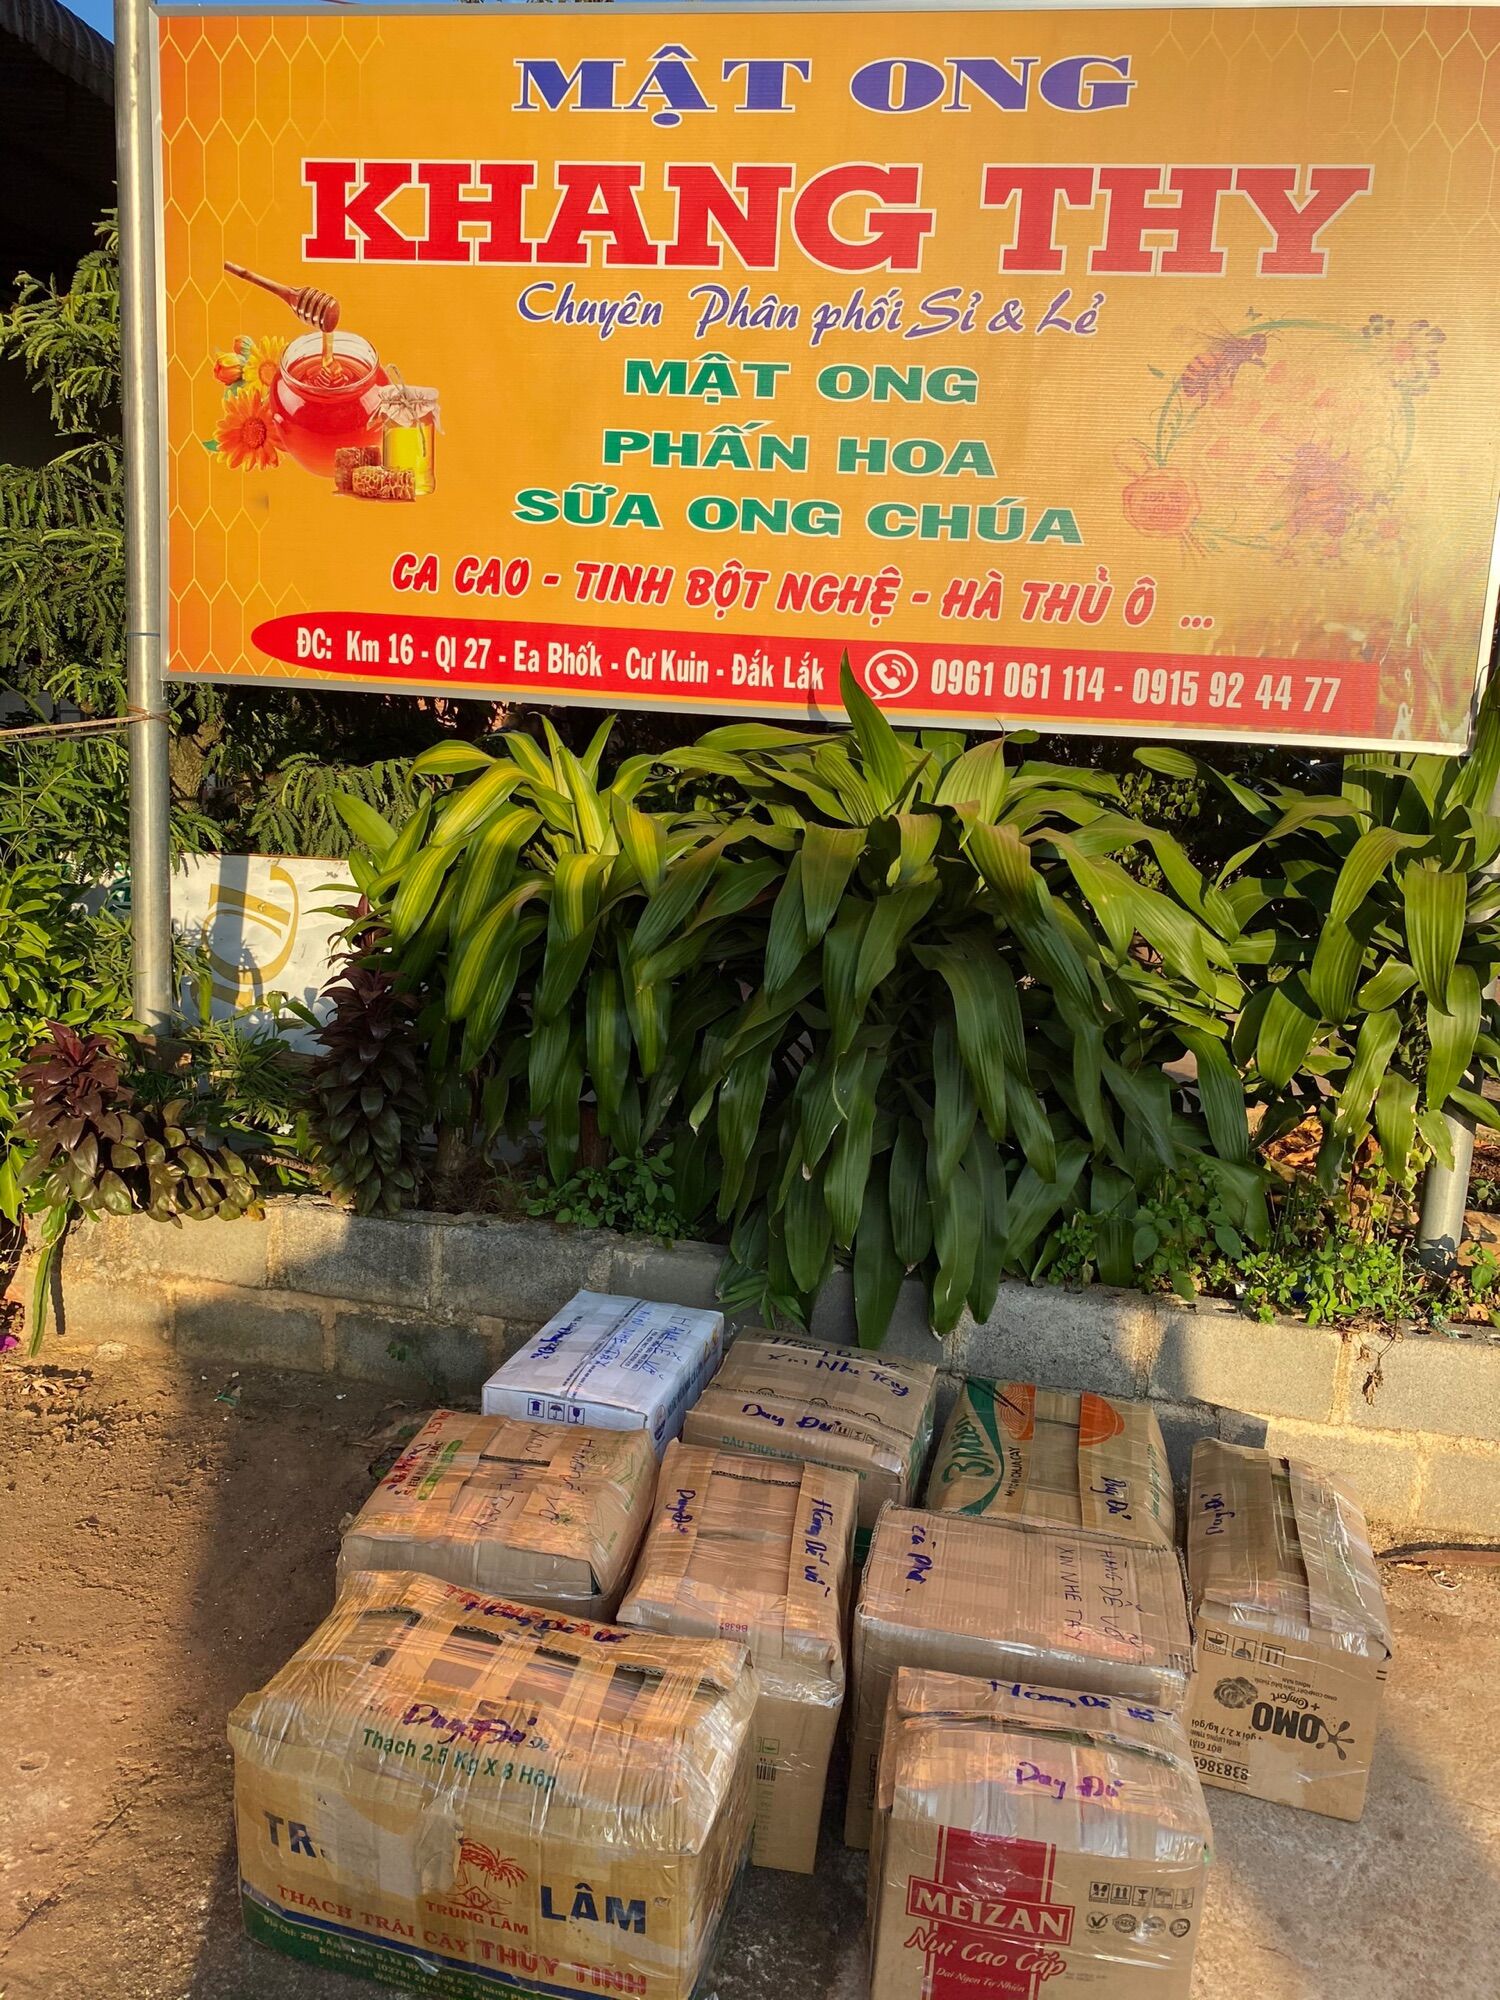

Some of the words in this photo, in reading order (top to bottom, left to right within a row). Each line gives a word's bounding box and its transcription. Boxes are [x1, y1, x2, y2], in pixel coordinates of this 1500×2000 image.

[513, 43, 811, 128] MẬT
[851, 55, 1137, 114] ONG
[301, 157, 935, 275] KHANG
[981, 163, 1374, 278] THY
[517, 281, 662, 339] Chuyên
[689, 284, 797, 339] Phân
[810, 286, 903, 346] phối
[904, 286, 981, 340] Sỉ
[988, 297, 1026, 332] &
[1037, 289, 1105, 338] Lẻ
[624, 351, 792, 405] MẬT
[816, 364, 979, 405] ONG
[602, 419, 809, 474] PHẤN
[837, 436, 998, 478] HOA
[511, 481, 664, 530] SỮA
[686, 495, 842, 537] ONG
[866, 496, 1084, 545] CHÚA
[391, 553, 440, 593] CA
[454, 553, 531, 597] CAO
[544, 573, 560, 586] -
[574, 561, 675, 606] TINH
[684, 559, 769, 619] BỘT
[775, 565, 901, 629] NGHỆ
[911, 594, 929, 605] -
[940, 570, 1003, 622] HÀ
[1020, 565, 1114, 626] THỦ
[1123, 576, 1159, 629] Ô
[296, 626, 332, 661] ĐC:
[346, 631, 381, 664] Km
[387, 634, 414, 665] 16
[465, 638, 490, 670] 27
[513, 642, 542, 674] Ea
[546, 639, 603, 678] Bhốk
[626, 646, 658, 679] Cư
[660, 648, 709, 684] Kuin
[731, 652, 774, 689] Đắk
[782, 653, 825, 691] Lắk
[930, 659, 994, 698] 0961
[1003, 662, 1050, 700] 061
[1062, 665, 1105, 703] 114
[1132, 667, 1199, 709] 0915
[1208, 671, 1243, 709] 92
[1254, 673, 1292, 711] 44
[1304, 676, 1342, 714] 77
[1252, 1702, 1321, 1743] OMO
[1271, 1691, 1309, 1709] Comfort
[364, 1728, 417, 1758] Thạch
[454, 1751, 479, 1776] Kg
[484, 1758, 499, 1777] X
[425, 1901, 485, 1925] TRUNG
[491, 1918, 529, 1936] LÂM
[541, 1882, 646, 1934] LÂM
[915, 1887, 1066, 1937] MEIZAN
[277, 1883, 352, 1919] THẠCH
[423, 1930, 470, 1955] CÂY
[571, 1962, 647, 1997] TINH
[904, 1926, 958, 1957] Nui
[960, 1942, 1008, 1967] Cao
[1015, 1951, 1067, 1983] Cấp
[955, 1972, 981, 1986] Ngon
